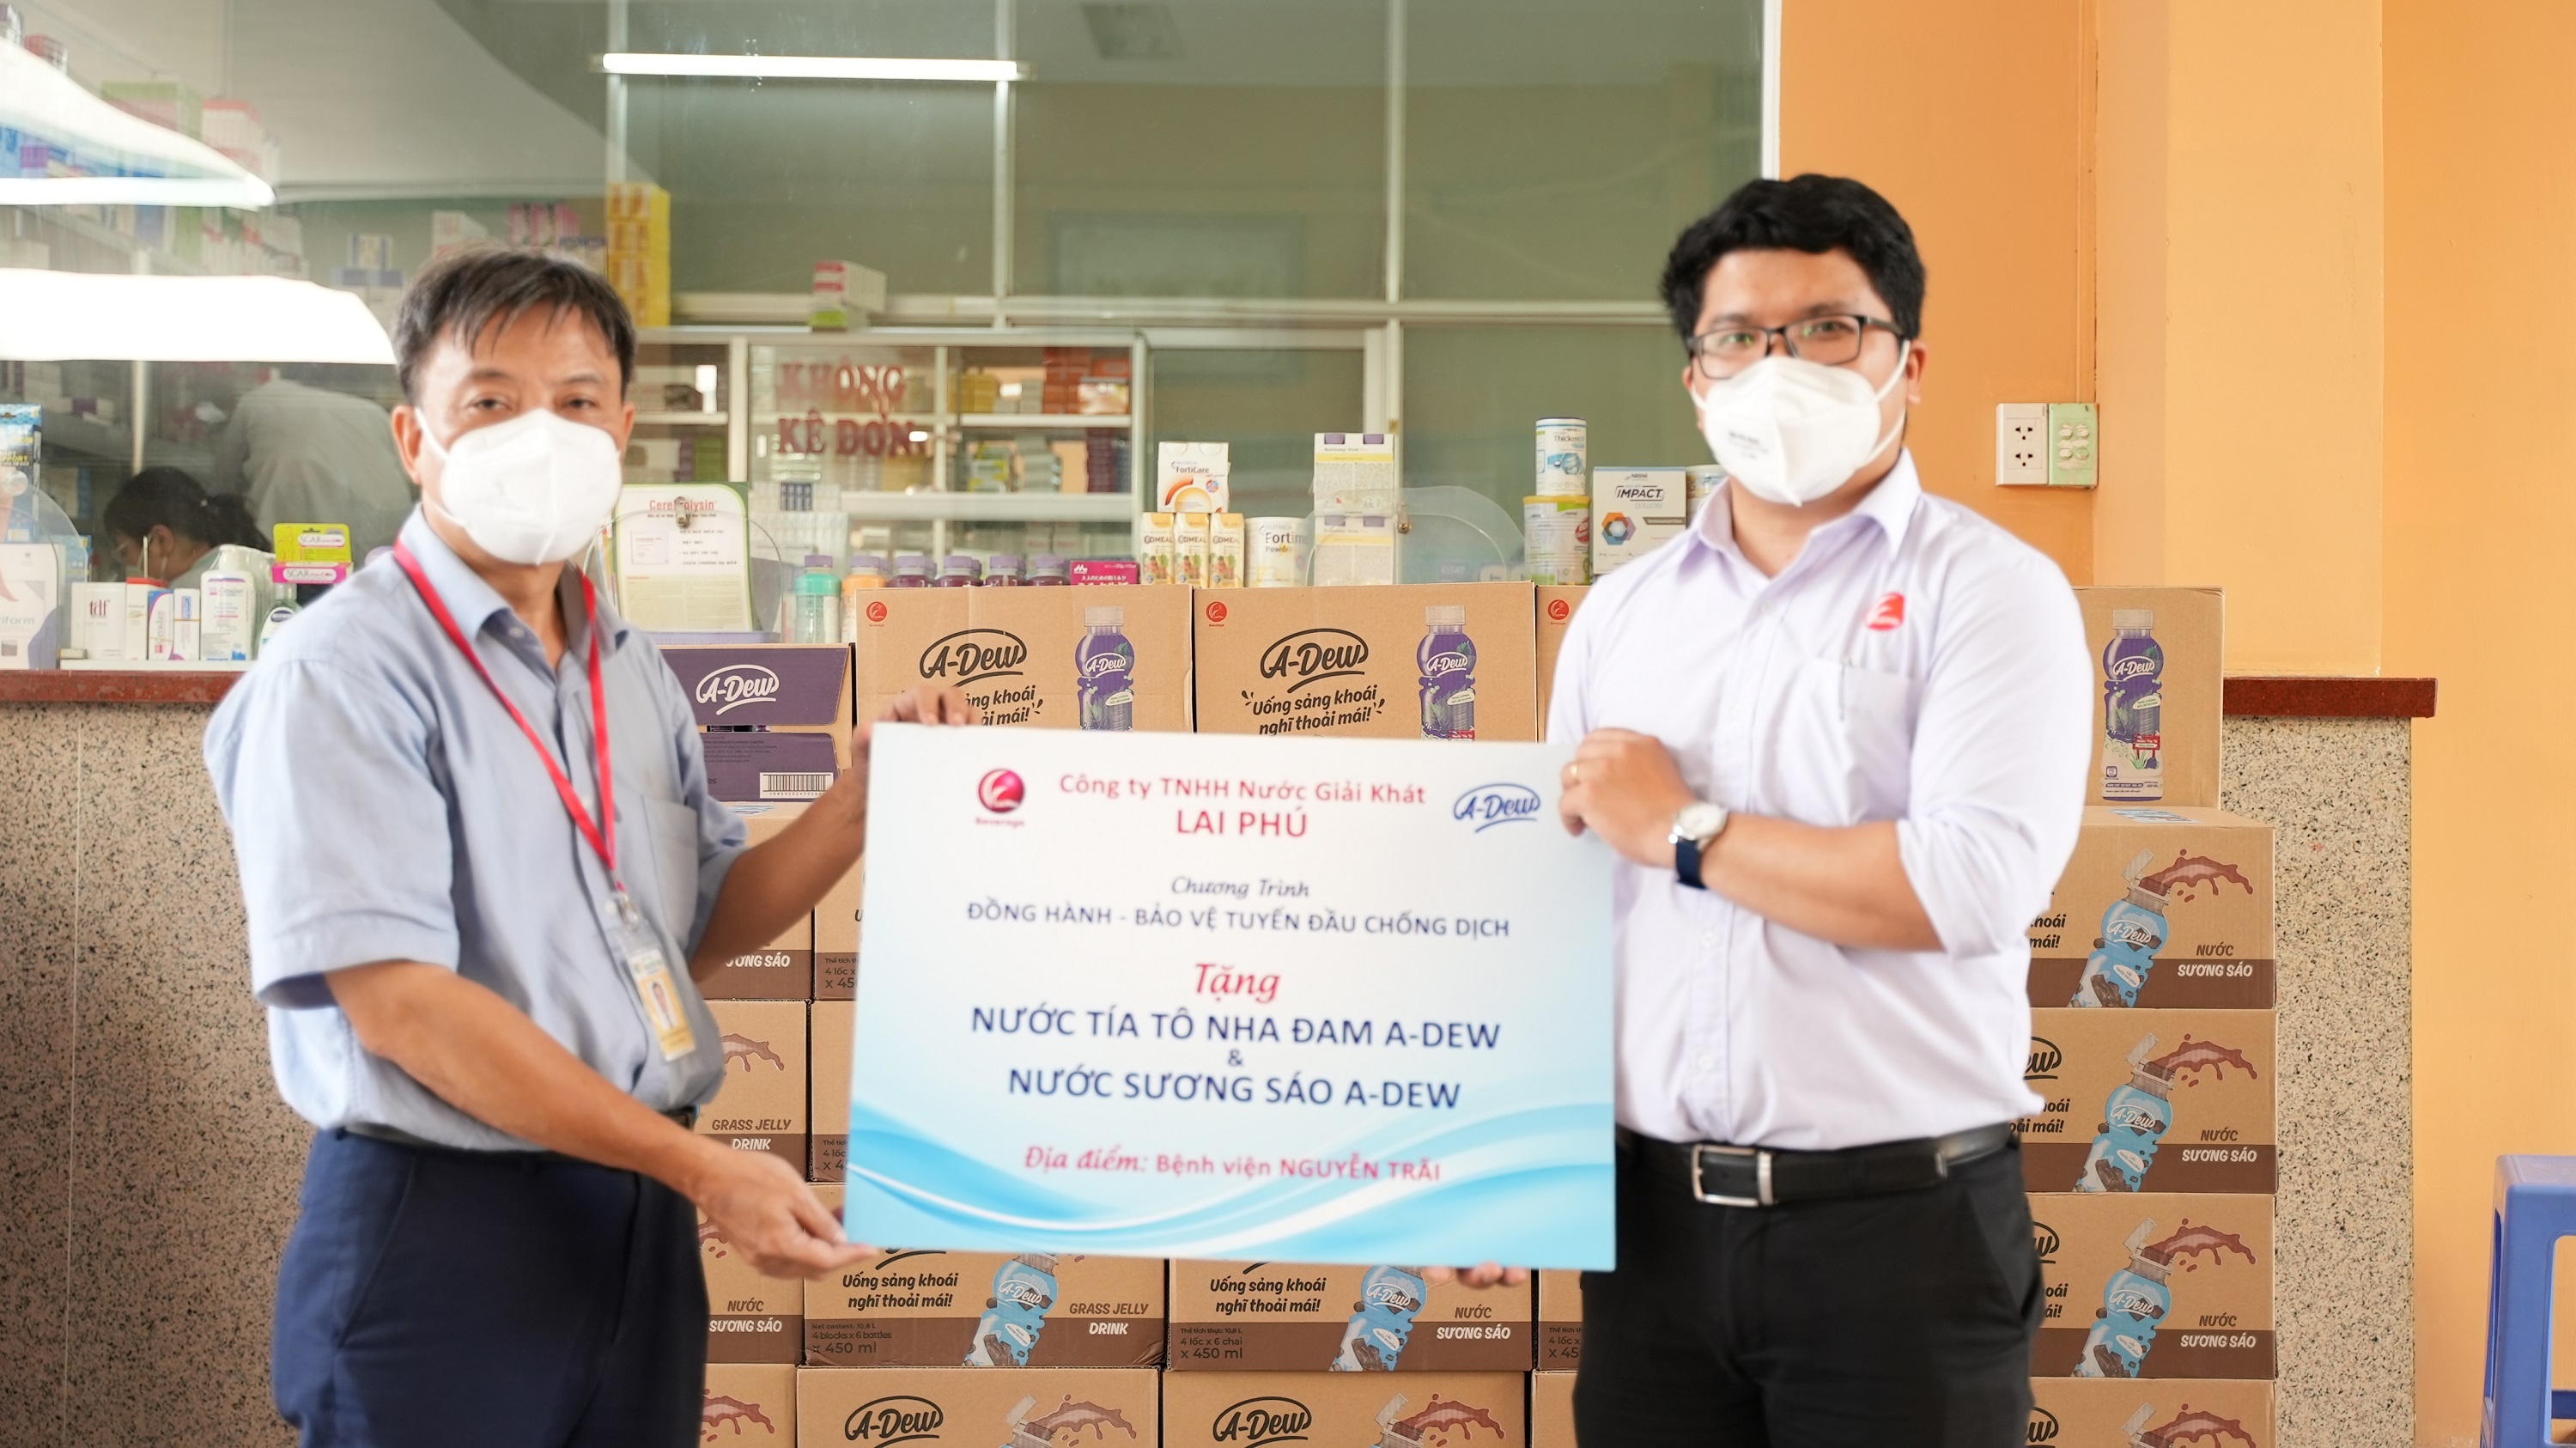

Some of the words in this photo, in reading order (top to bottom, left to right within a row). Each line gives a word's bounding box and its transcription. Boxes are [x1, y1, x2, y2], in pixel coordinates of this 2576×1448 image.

[1617, 489, 1663, 498] IMPACT
[649, 499, 714, 512] Cereolysin
[920, 629, 1027, 679] A-Dew
[1261, 628, 1369, 679] A-Dew
[1426, 651, 1468, 672] A-Dew
[1084, 653, 1127, 672] A-Dew
[2113, 655, 2155, 676] A-Dew
[696, 664, 779, 704] A-Dew
[993, 684, 1036, 705] khoái
[1252, 694, 1291, 716] Uống
[1294, 691, 1331, 712] sảng
[1334, 684, 1378, 705] khoái
[996, 706, 1030, 725] mái!
[1259, 718, 1292, 736] nghĩ
[1296, 710, 1335, 731] thoải
[1338, 707, 1372, 725] mái!
[1060, 773, 1119, 800] Công
[1128, 778, 1151, 800] ty
[1161, 777, 1229, 798] TNHH
[1240, 780, 1306, 800] Nước
[1315, 782, 1362, 803] Giải
[1371, 784, 1425, 805] Khát
[1454, 783, 1540, 821] A-Dew
[1176, 810, 1224, 836] LAI
[1239, 806, 1308, 838] PHÚ
[1171, 876, 1249, 899] Chương
[967, 897, 1036, 923] ĐỒNG
[1046, 899, 1113, 924] HÀNH
[1135, 901, 1182, 927] BẢO
[1191, 909, 1218, 933] VỆ
[1227, 906, 1299, 931] TUYẾN
[1309, 908, 1356, 934] ĐẦU
[1364, 910, 1448, 936] CHỐNG
[1456, 918, 1510, 940] DỊCH
[2030, 914, 2067, 928] hoái
[2106, 920, 2152, 944] A-Dew
[2029, 934, 2061, 949] mái!
[2196, 941, 2234, 957] NƯỚC
[764, 952, 791, 967] SÁO
[834, 966, 848, 976] lốc
[2178, 964, 2224, 977] SƯƠNG
[2226, 962, 2253, 977] SÁO
[825, 980, 833, 989] x
[1194, 963, 1281, 1004] Tặng
[972, 1002, 1076, 1036] NƯỚC
[1087, 1005, 1139, 1038] TÍA
[1151, 1007, 1194, 1040] TÔ
[1206, 1016, 1280, 1043] NHA
[1291, 1019, 1372, 1046] ĐAM
[1385, 1021, 1501, 1049] A-DEW
[1227, 1049, 1244, 1068] &
[1009, 1064, 1114, 1098] NƯỚC
[1123, 1072, 1255, 1103] SƯƠNG
[1266, 1072, 1333, 1105] SÁO
[1345, 1080, 1461, 1109] A-DEW
[2044, 1098, 2070, 1113] oái
[712, 1119, 753, 1131] GRASS
[755, 1119, 792, 1131] JELLY
[2110, 1104, 2155, 1129] A-Dew
[2032, 1118, 2064, 1134] mái!
[2200, 1127, 2239, 1141] NƯỚC
[732, 1138, 771, 1151] DRINK
[832, 1147, 846, 1157] lốc
[1024, 1145, 1069, 1174] Địa
[1077, 1144, 1146, 1172] điểm:
[1157, 1154, 1214, 1177] Bệnh
[1223, 1156, 1271, 1177] viện
[1280, 1153, 1379, 1180] NGUYỄN
[1388, 1158, 1441, 1181] TRÃI
[2182, 1149, 2228, 1163] SƯƠNG
[2230, 1147, 2257, 1162] SÁO
[842, 1270, 878, 1290] Uống
[881, 1273, 915, 1290] sảng
[918, 1272, 959, 1287] khoái
[1210, 1275, 1247, 1294] Uống
[1249, 1278, 1284, 1294] sảng
[1286, 1277, 1327, 1292] khoái
[999, 1280, 1042, 1304] A-Dew
[1366, 1283, 1412, 1306] A-Dew
[2045, 1283, 2069, 1298] oái
[726, 1297, 764, 1312] NƯỚC
[848, 1295, 881, 1311] nghĩ
[882, 1293, 920, 1308] thoải
[921, 1293, 953, 1308] mái!
[1069, 1303, 1110, 1315] GRASS
[1113, 1303, 1149, 1315] JELLY
[1215, 1300, 1249, 1316] nghĩ
[1250, 1298, 1287, 1312] thoải
[1290, 1299, 1321, 1312] mái!
[2109, 1290, 2154, 1315] A-Dew
[1455, 1304, 1492, 1318] NƯỚC
[2045, 1305, 2063, 1318] ái!
[2199, 1311, 2237, 1328] NƯỚC
[709, 1317, 755, 1332] SƯƠNG
[756, 1316, 782, 1332] SÁO
[1089, 1323, 1129, 1335] DRINK
[1437, 1326, 1483, 1340] SƯƠNG
[1485, 1323, 1511, 1340] SÁO
[820, 1331, 848, 1340] blocks
[1189, 1337, 1203, 1346] lốc
[1222, 1337, 1242, 1346] chai
[1558, 1335, 1572, 1345] lốc
[2180, 1335, 2227, 1348] SƯƠNG
[2228, 1332, 2257, 1348] SÁO
[812, 1345, 821, 1354] x
[825, 1342, 853, 1354] 450
[859, 1342, 877, 1353] ml
[1181, 1350, 1188, 1359] x
[1193, 1348, 1220, 1359] 450
[1224, 1347, 1242, 1359] ml
[1549, 1349, 1557, 1358] x
[1561, 1348, 1579, 1358] 45
[845, 1395, 944, 1441] A-Dew
[1212, 1396, 1312, 1442] A-Dew
